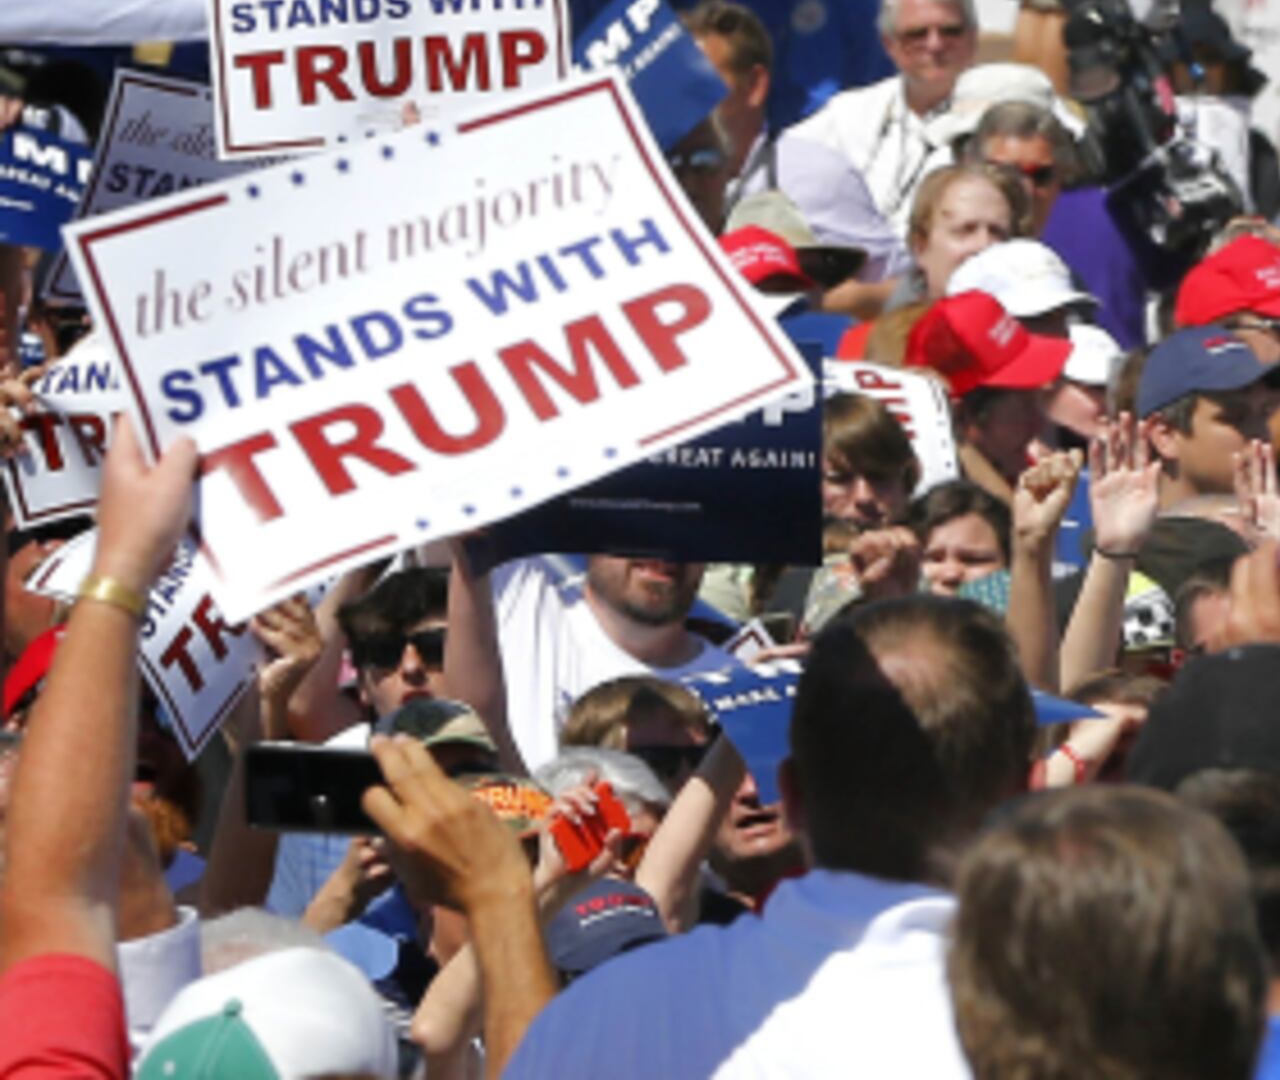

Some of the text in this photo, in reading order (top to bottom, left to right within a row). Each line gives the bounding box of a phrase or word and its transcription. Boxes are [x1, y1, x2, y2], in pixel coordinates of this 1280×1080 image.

[233, 28, 547, 110] TRUMP
[133, 150, 626, 340] the silent majority
[159, 216, 674, 424] STANDS WITH
[199, 282, 715, 524] TRUMP
[731, 448, 816, 469] AGAIN!
